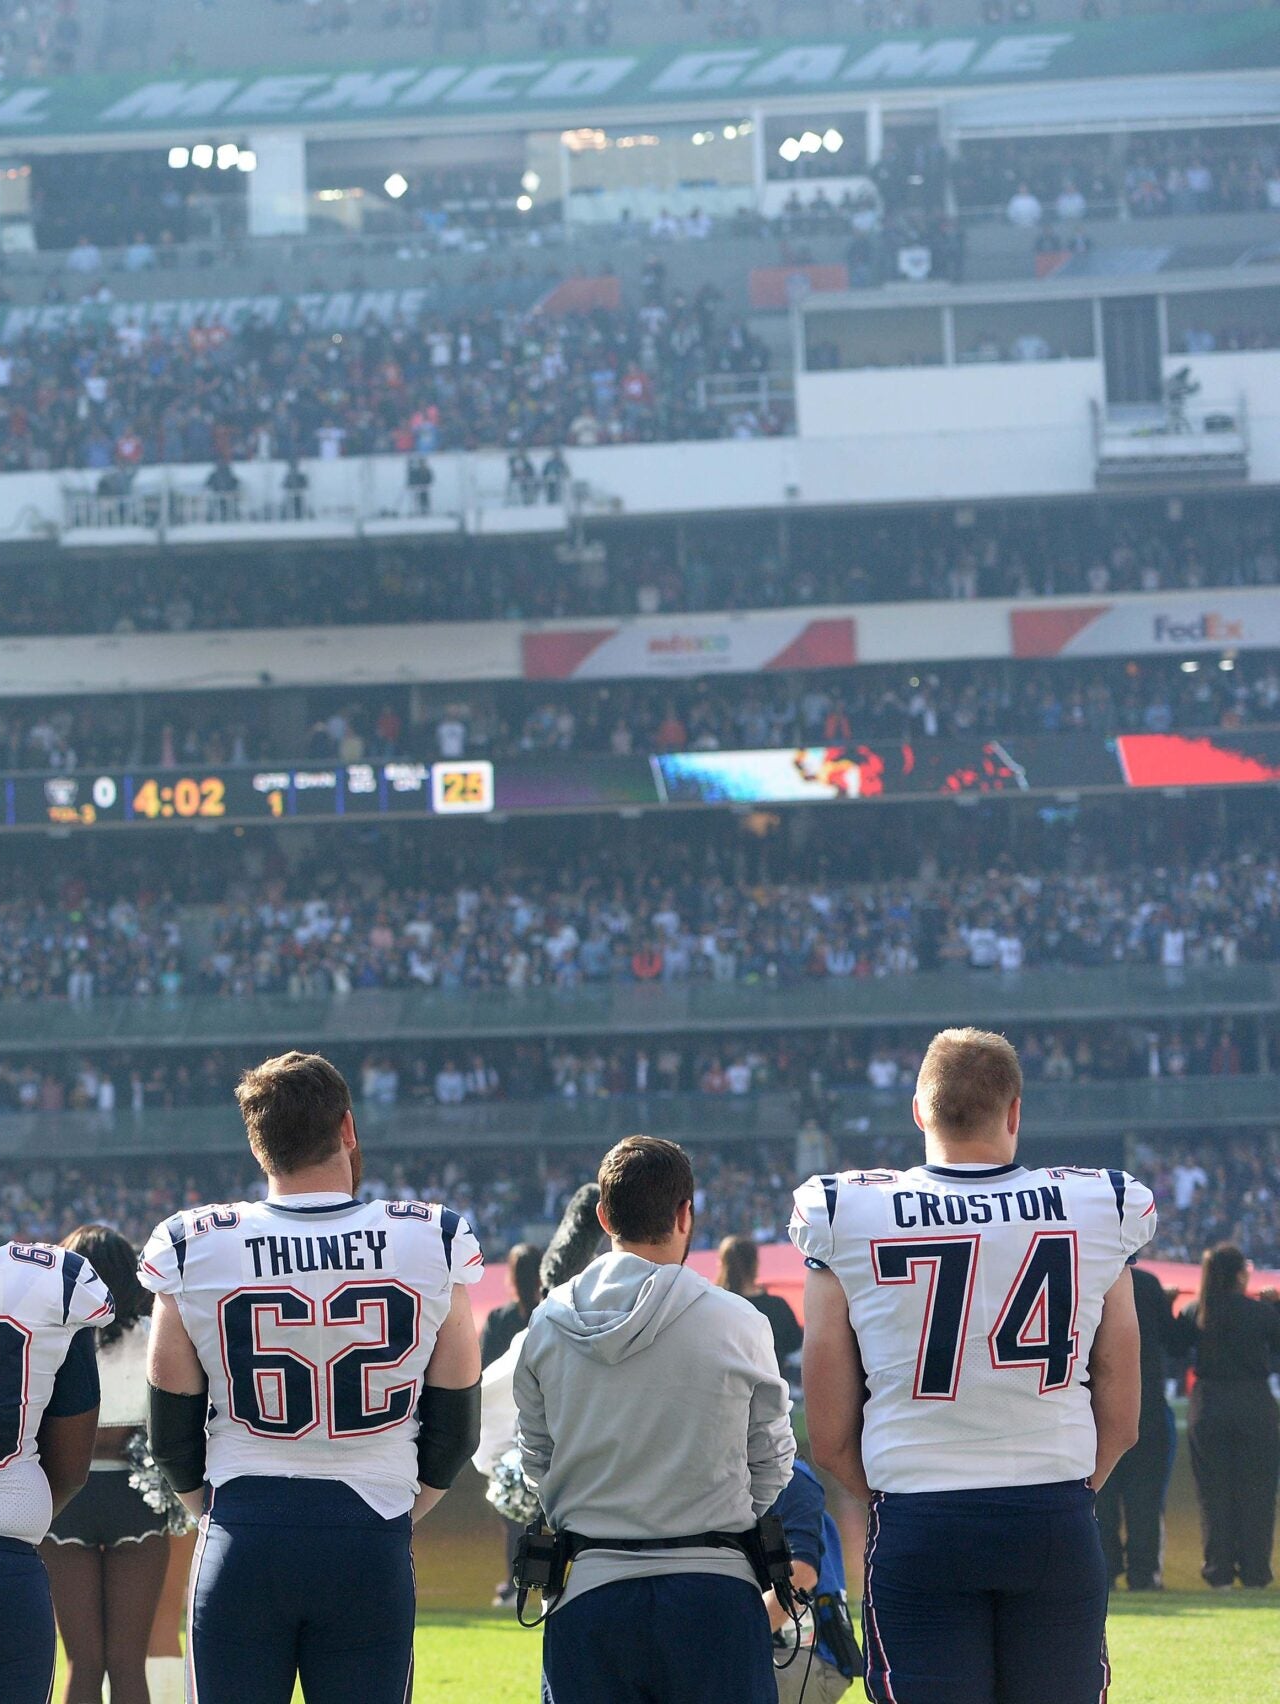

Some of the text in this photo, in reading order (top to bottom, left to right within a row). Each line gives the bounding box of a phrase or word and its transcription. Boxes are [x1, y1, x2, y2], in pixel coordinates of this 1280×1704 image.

[98, 57, 638, 122] MEXICO
[649, 33, 1075, 91] GAME
[1153, 611, 1244, 641] FedEx
[93, 776, 117, 809] 0
[132, 776, 226, 819] 4:02
[267, 790, 284, 818] 1
[443, 771, 484, 804] 25
[892, 1185, 1068, 1229] CROSTON
[245, 1230, 387, 1278] THUNEY
[870, 1230, 1080, 1402] 74
[217, 1278, 422, 1440] 62
